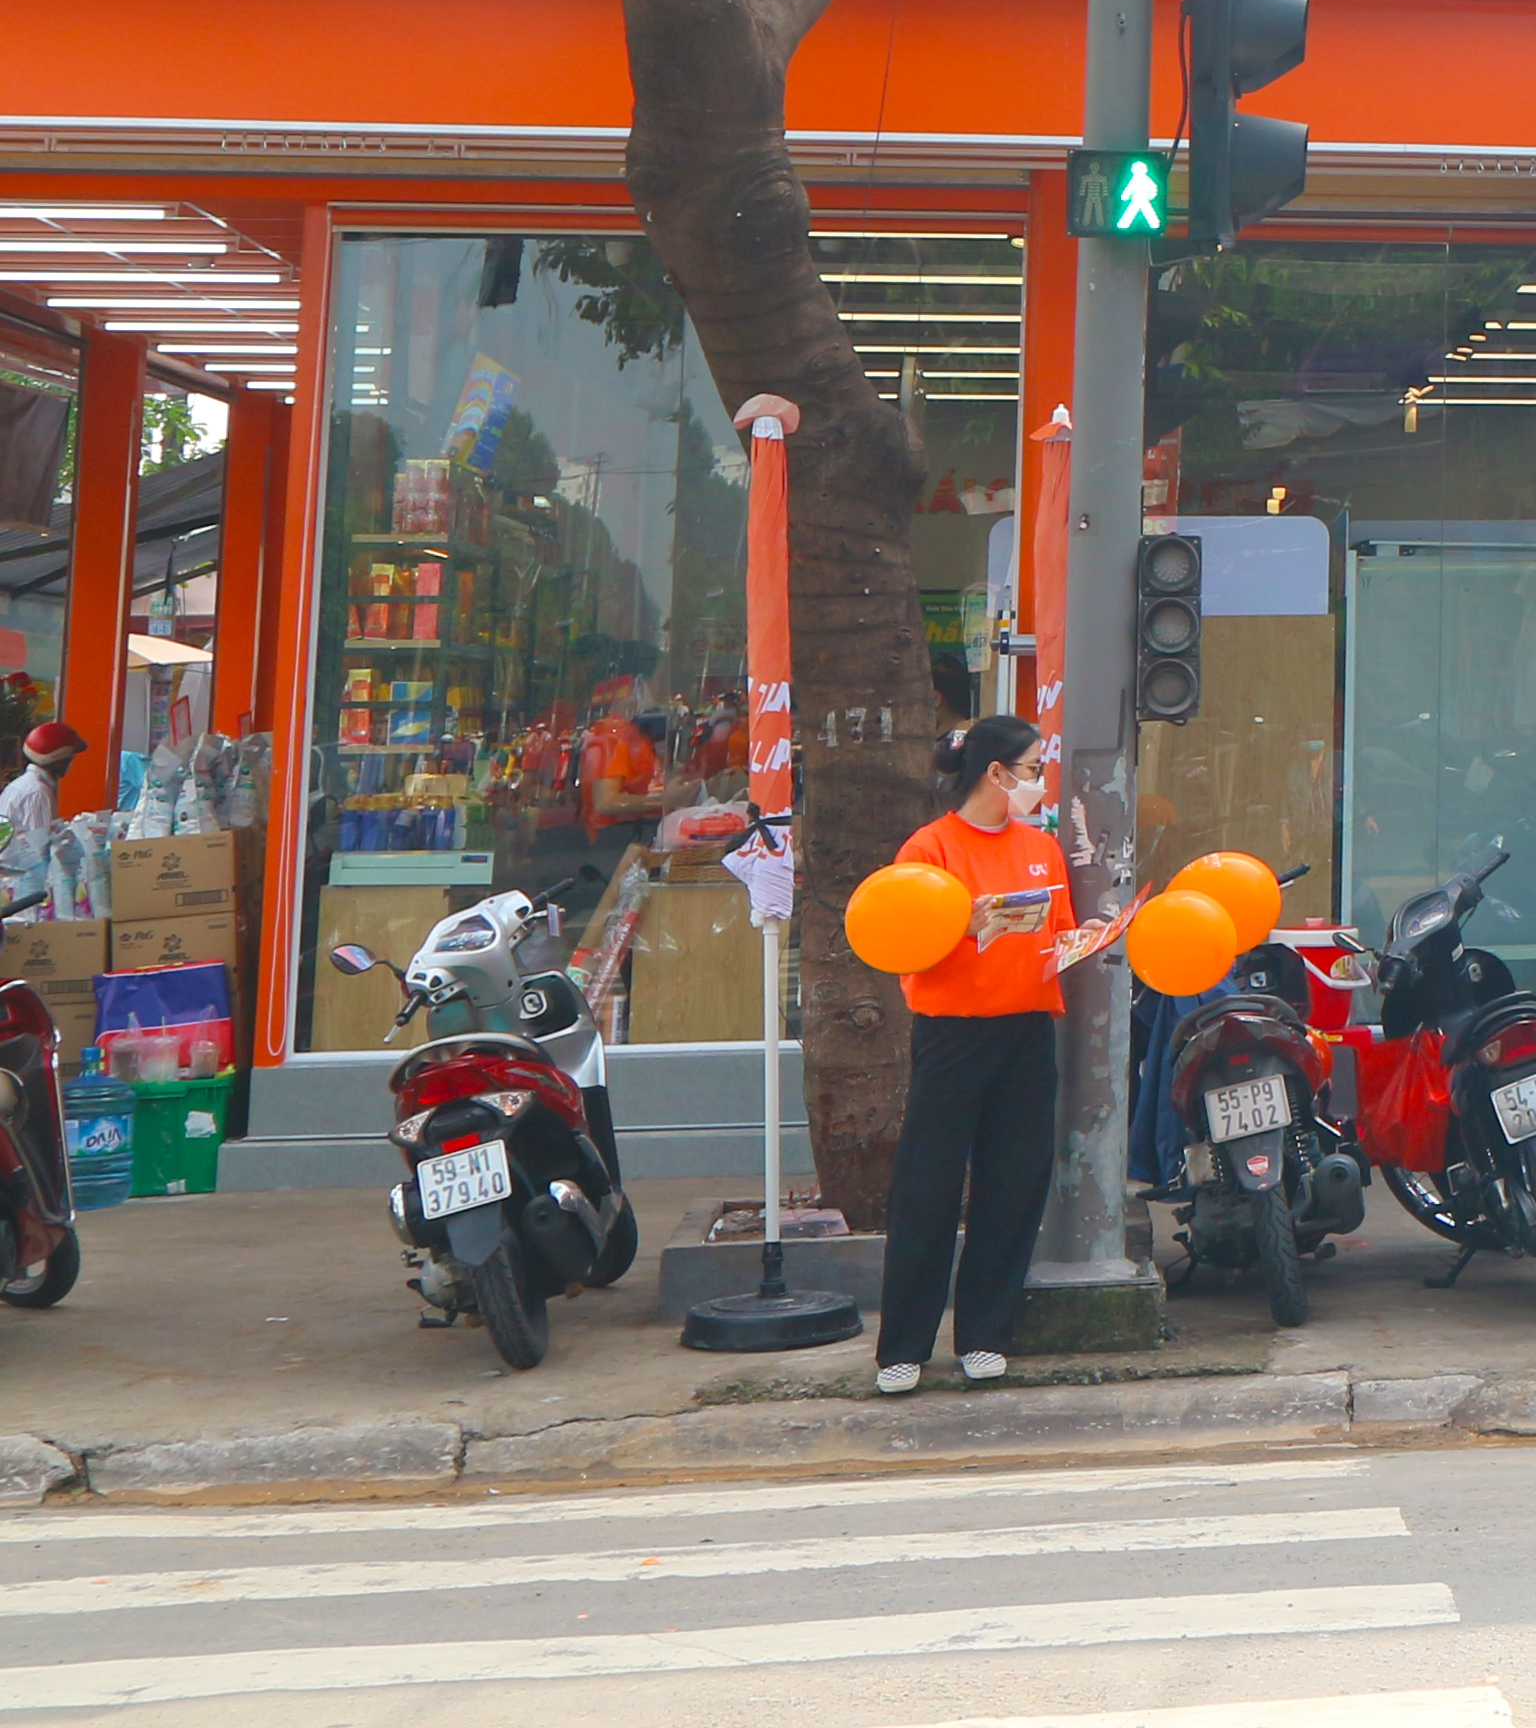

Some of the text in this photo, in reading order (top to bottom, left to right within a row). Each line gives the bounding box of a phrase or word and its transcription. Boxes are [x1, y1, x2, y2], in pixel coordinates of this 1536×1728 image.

[1218, 1082, 1275, 1113] 55-P9
[1221, 1105, 1279, 1137] 7402
[430, 1149, 491, 1184] 59-N1
[427, 1173, 506, 1214] 379.40
